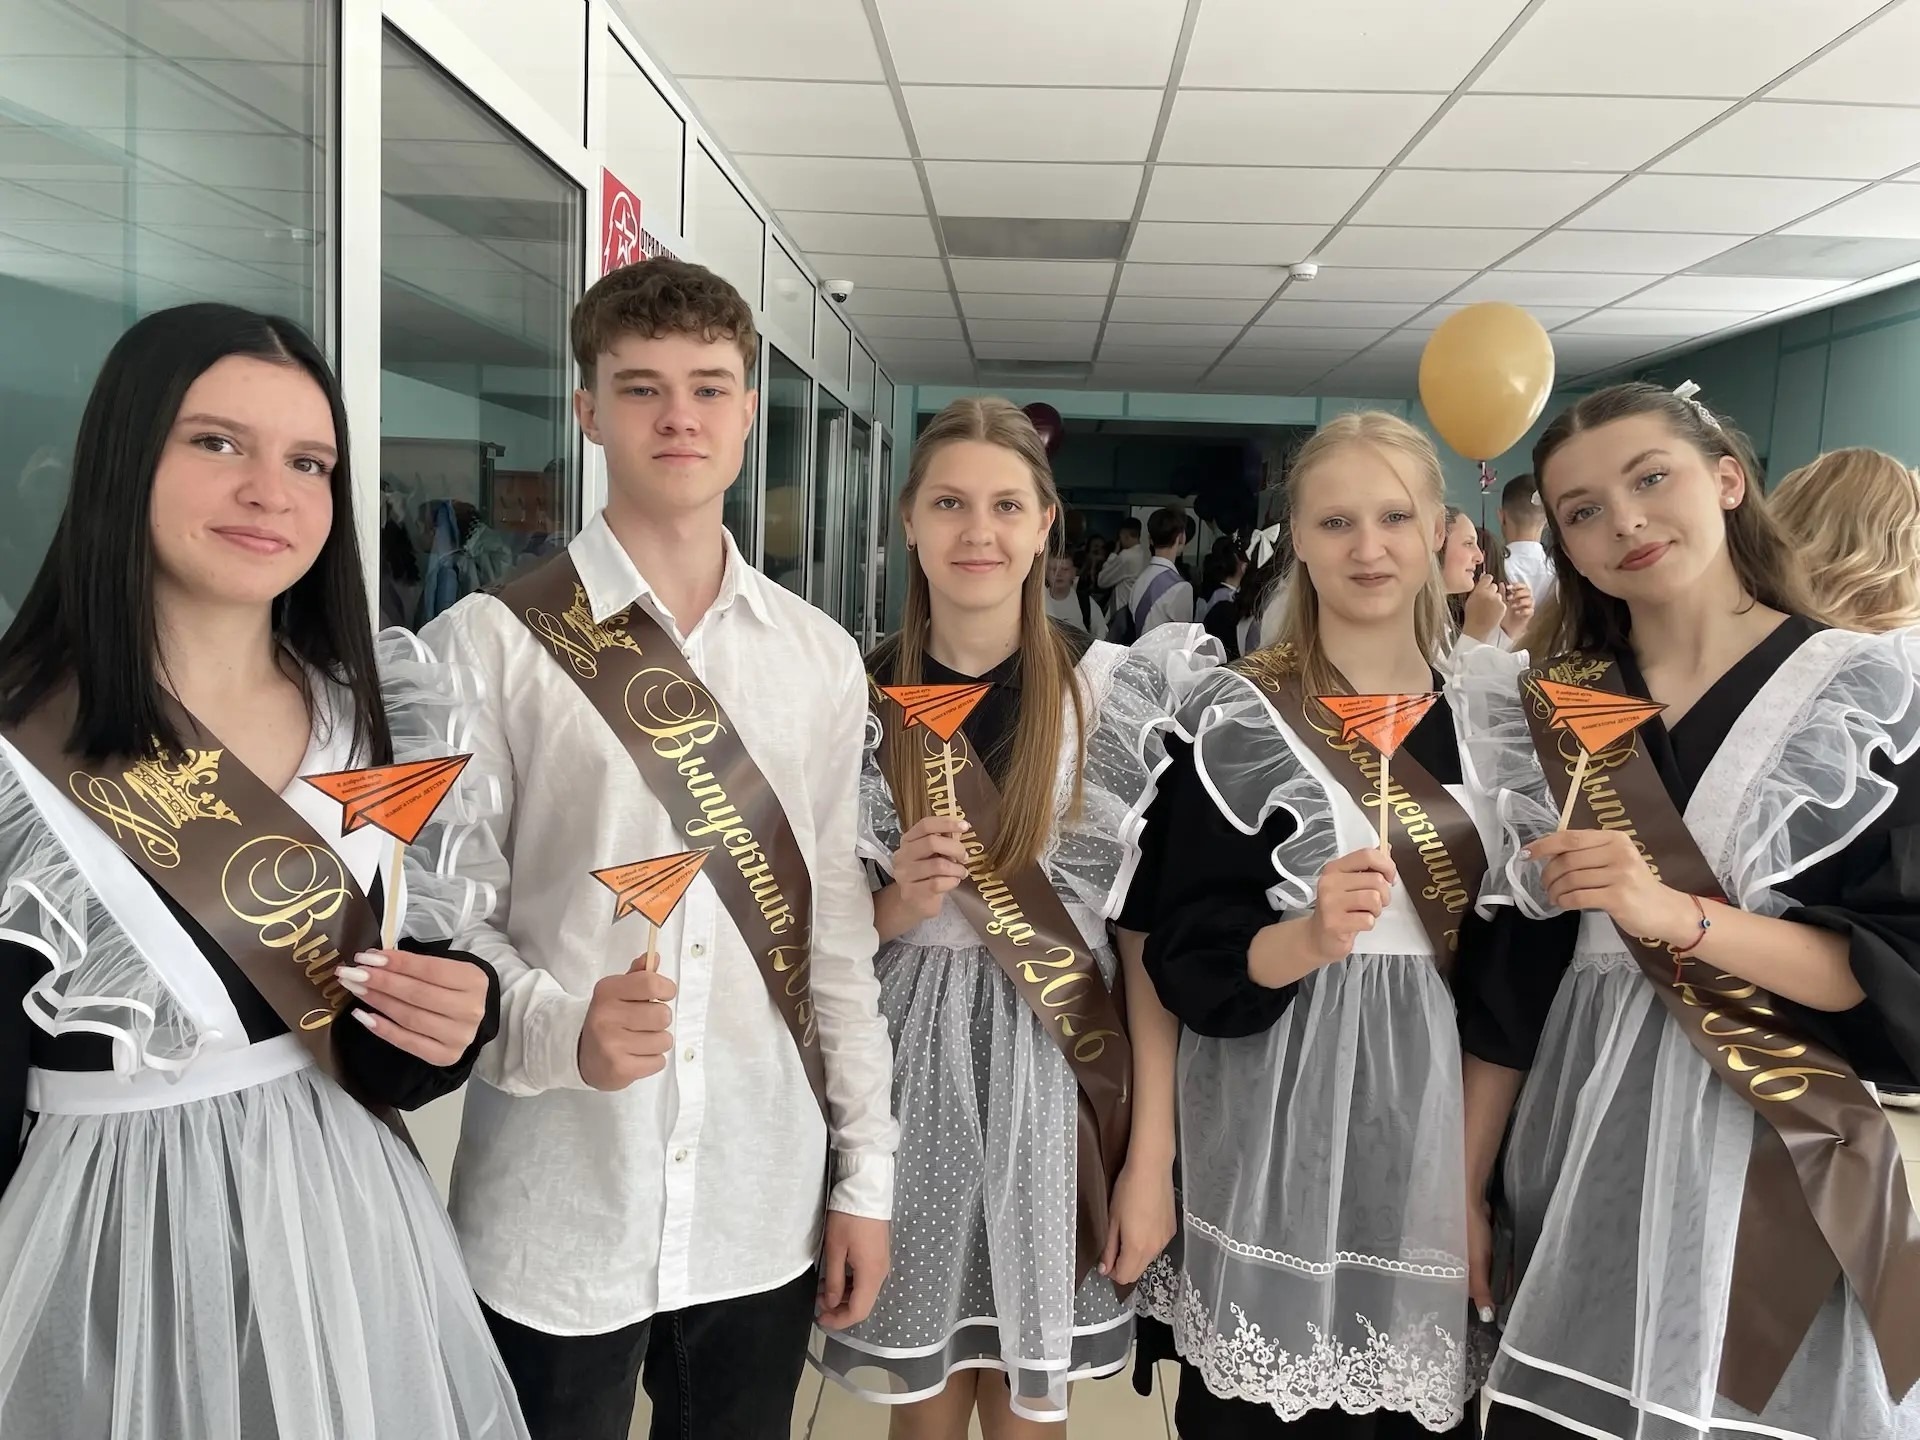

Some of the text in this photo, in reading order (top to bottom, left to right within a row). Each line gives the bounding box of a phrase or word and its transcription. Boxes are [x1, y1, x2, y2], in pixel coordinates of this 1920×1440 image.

[423, 778, 447, 797] ДЕТСТВА
[624, 667, 796, 935] Выпускник
[924, 730, 1120, 1063] Выскница 2026
